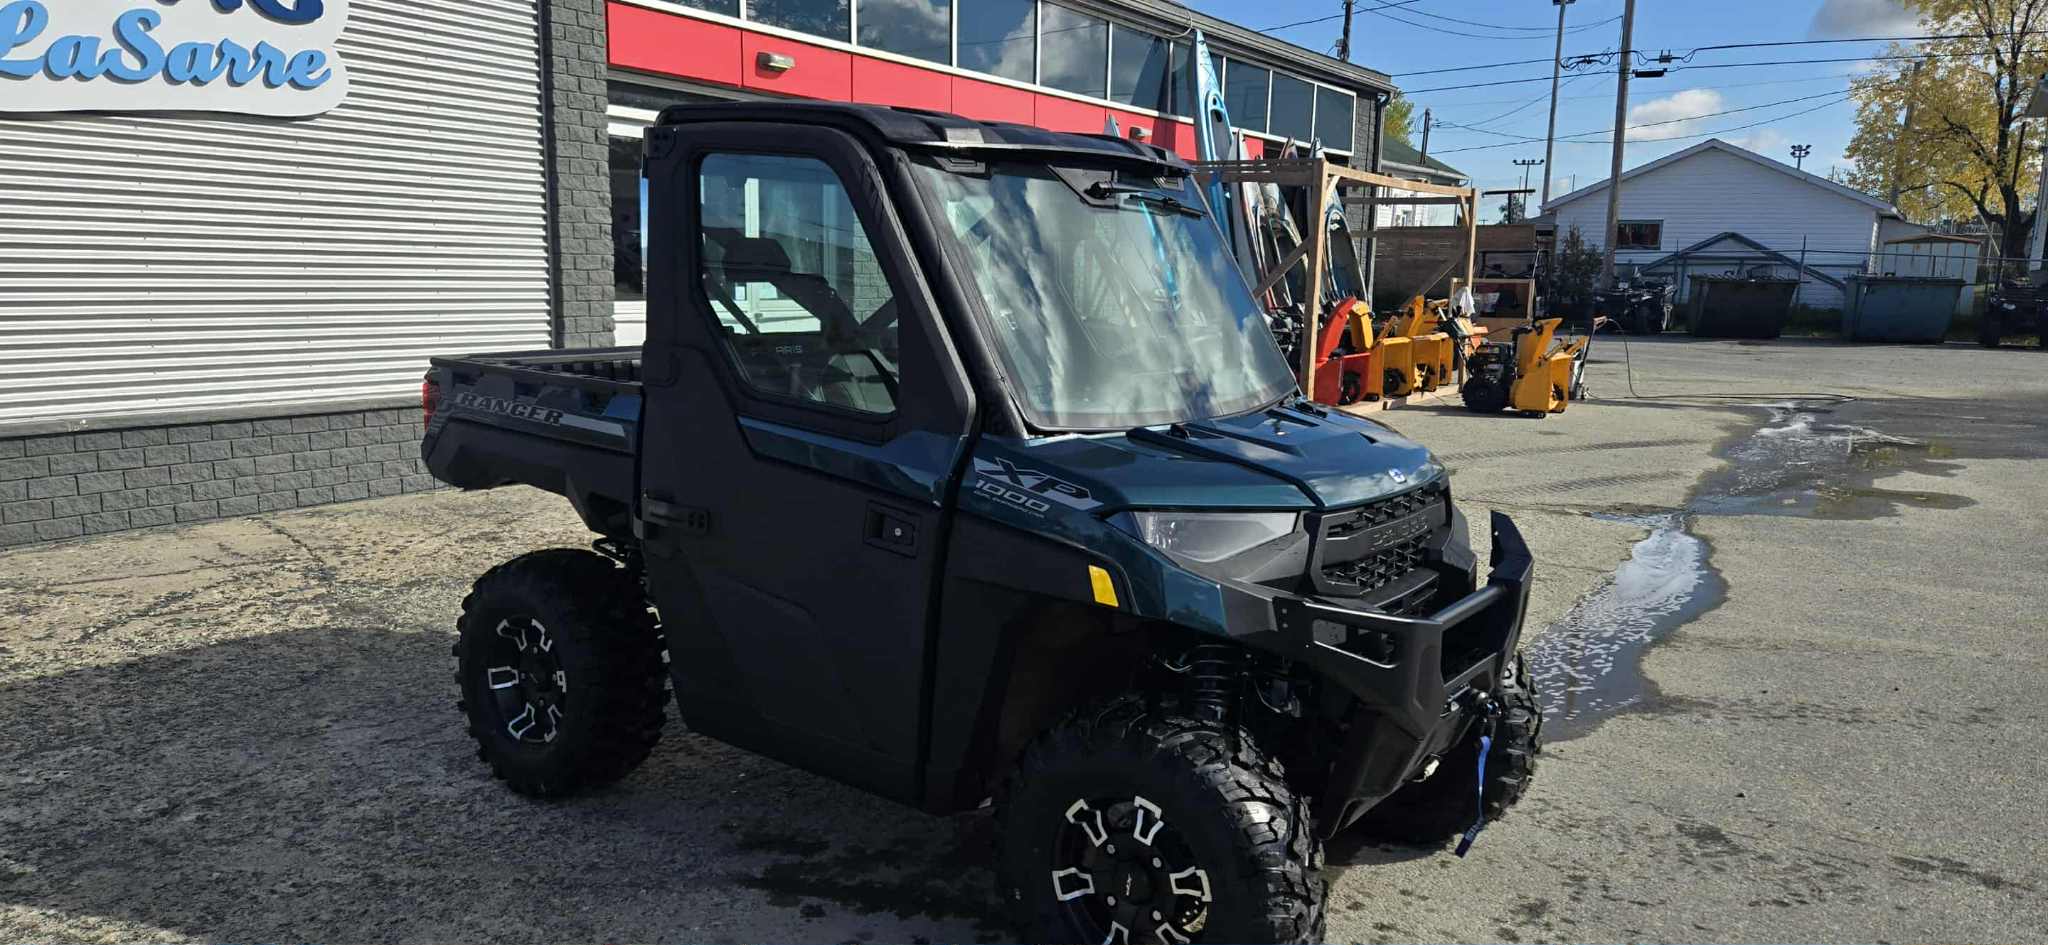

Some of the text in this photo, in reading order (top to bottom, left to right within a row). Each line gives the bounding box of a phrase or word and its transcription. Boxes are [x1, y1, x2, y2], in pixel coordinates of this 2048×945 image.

[0, 0, 331, 91] LaSarre
[456, 391, 566, 427] RANGER
[973, 456, 1104, 511] XP
[974, 479, 1051, 513] 1000
